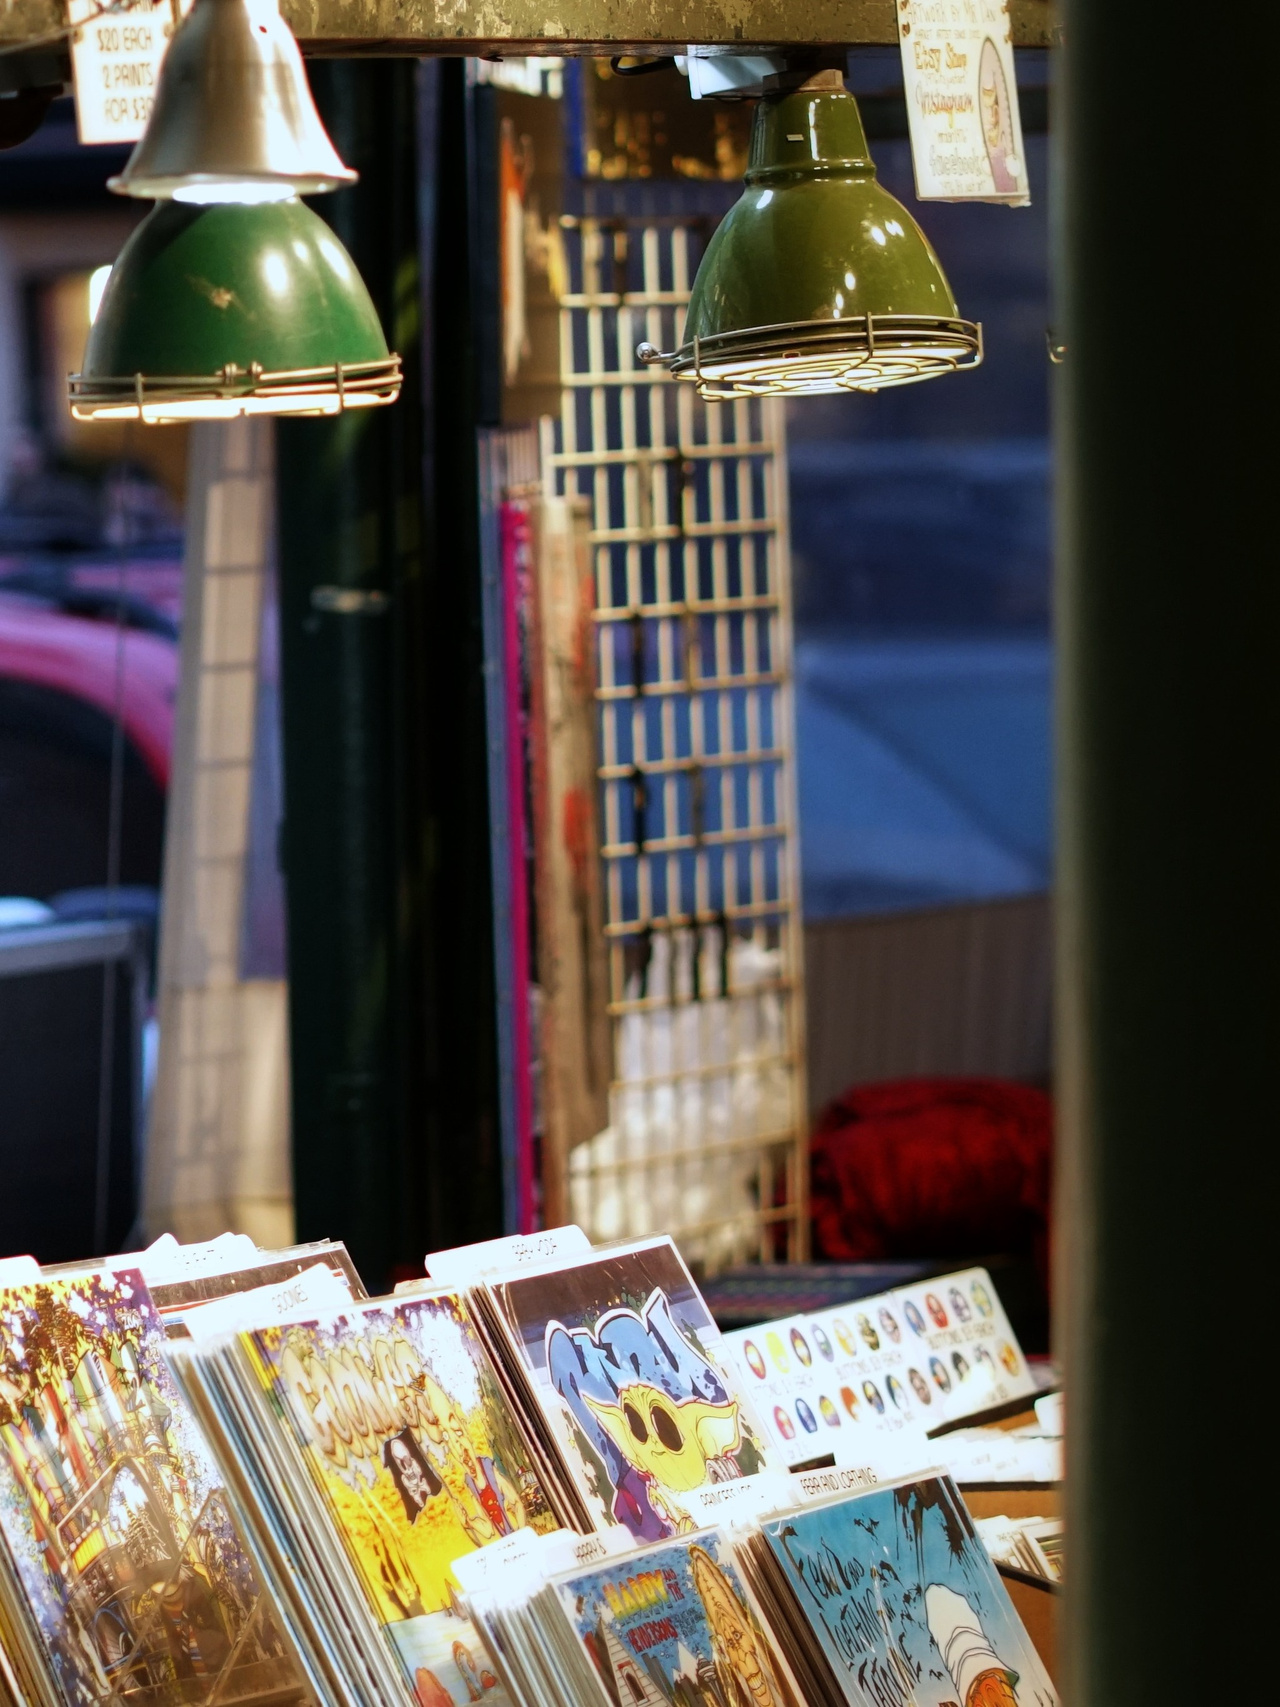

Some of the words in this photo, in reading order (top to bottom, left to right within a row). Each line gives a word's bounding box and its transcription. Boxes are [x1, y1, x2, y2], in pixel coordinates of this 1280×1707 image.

[96, 26, 120, 52] $20
[122, 26, 153, 52] EACH
[102, 63, 111, 89] 2
[800, 1476, 824, 1497] FEAR
[822, 1472, 840, 1493] AND
[840, 1466, 879, 1490] LOATHING
